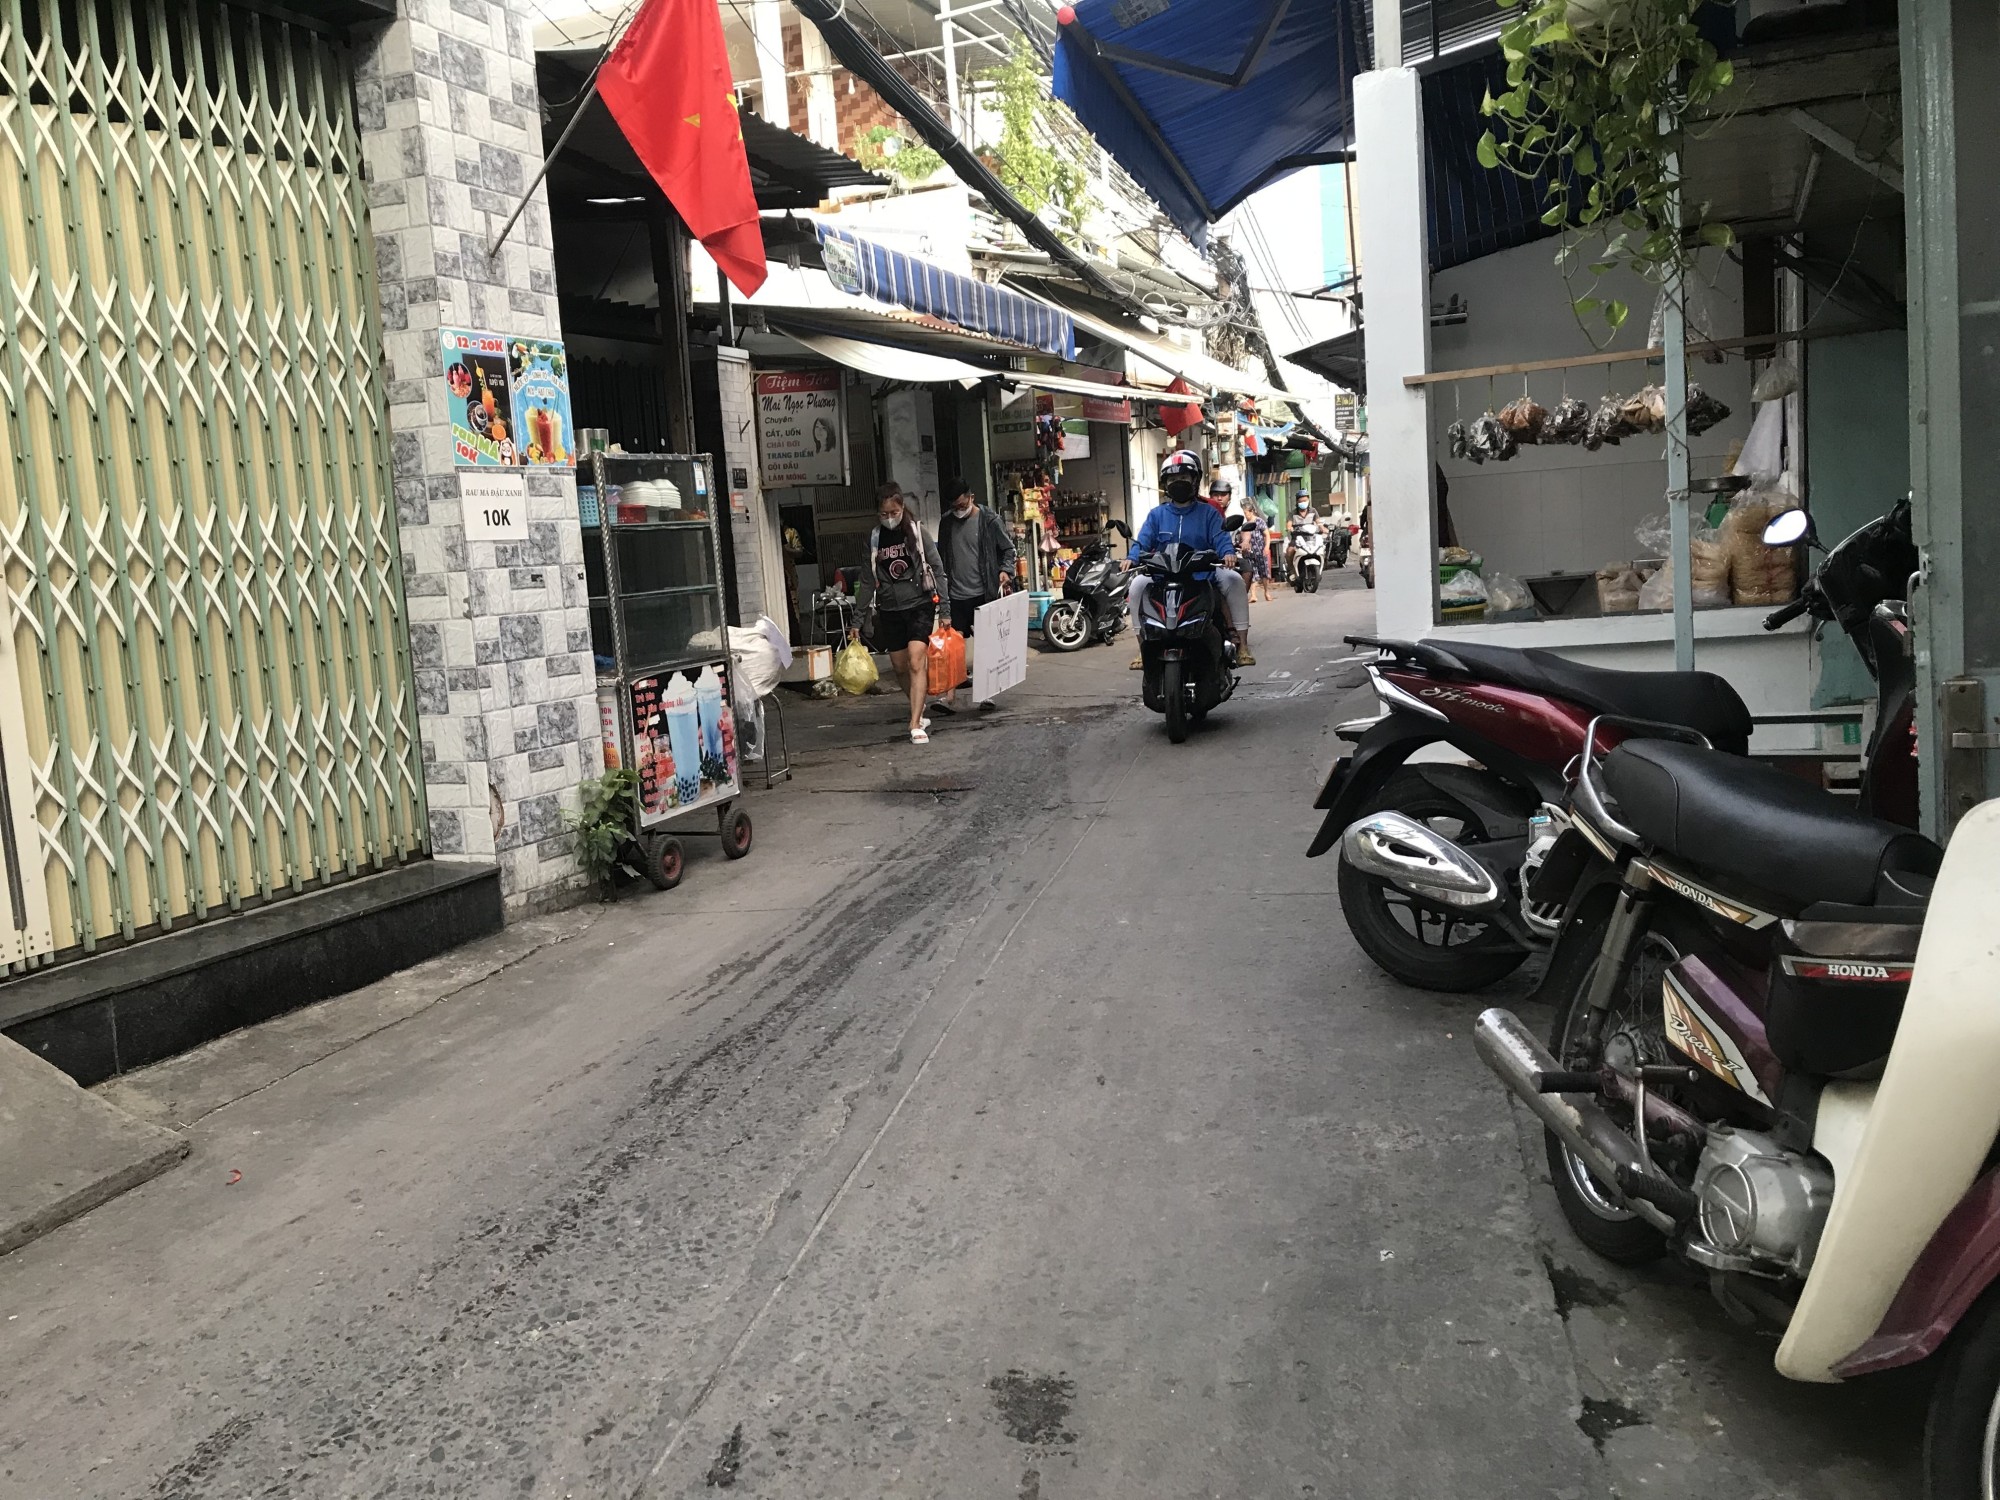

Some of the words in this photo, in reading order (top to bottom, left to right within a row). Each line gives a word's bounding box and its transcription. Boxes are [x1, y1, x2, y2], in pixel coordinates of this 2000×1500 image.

[456, 336, 469, 348] 12
[479, 339, 504, 352] 20K
[766, 375, 800, 390] Tiệm
[762, 396, 781, 412] Mai
[783, 394, 804, 414] Ngọc
[806, 392, 836, 412] Phương
[456, 440, 479, 464] 10K
[490, 488, 504, 497] ĐẬU
[483, 509, 511, 526] 10K
[1460, 696, 1505, 713] mode
[1674, 880, 1714, 908] HONDA
[1828, 964, 1889, 978] HONDA
[1669, 1014, 1720, 1064] Dream
[1724, 1061, 1744, 1072] II
